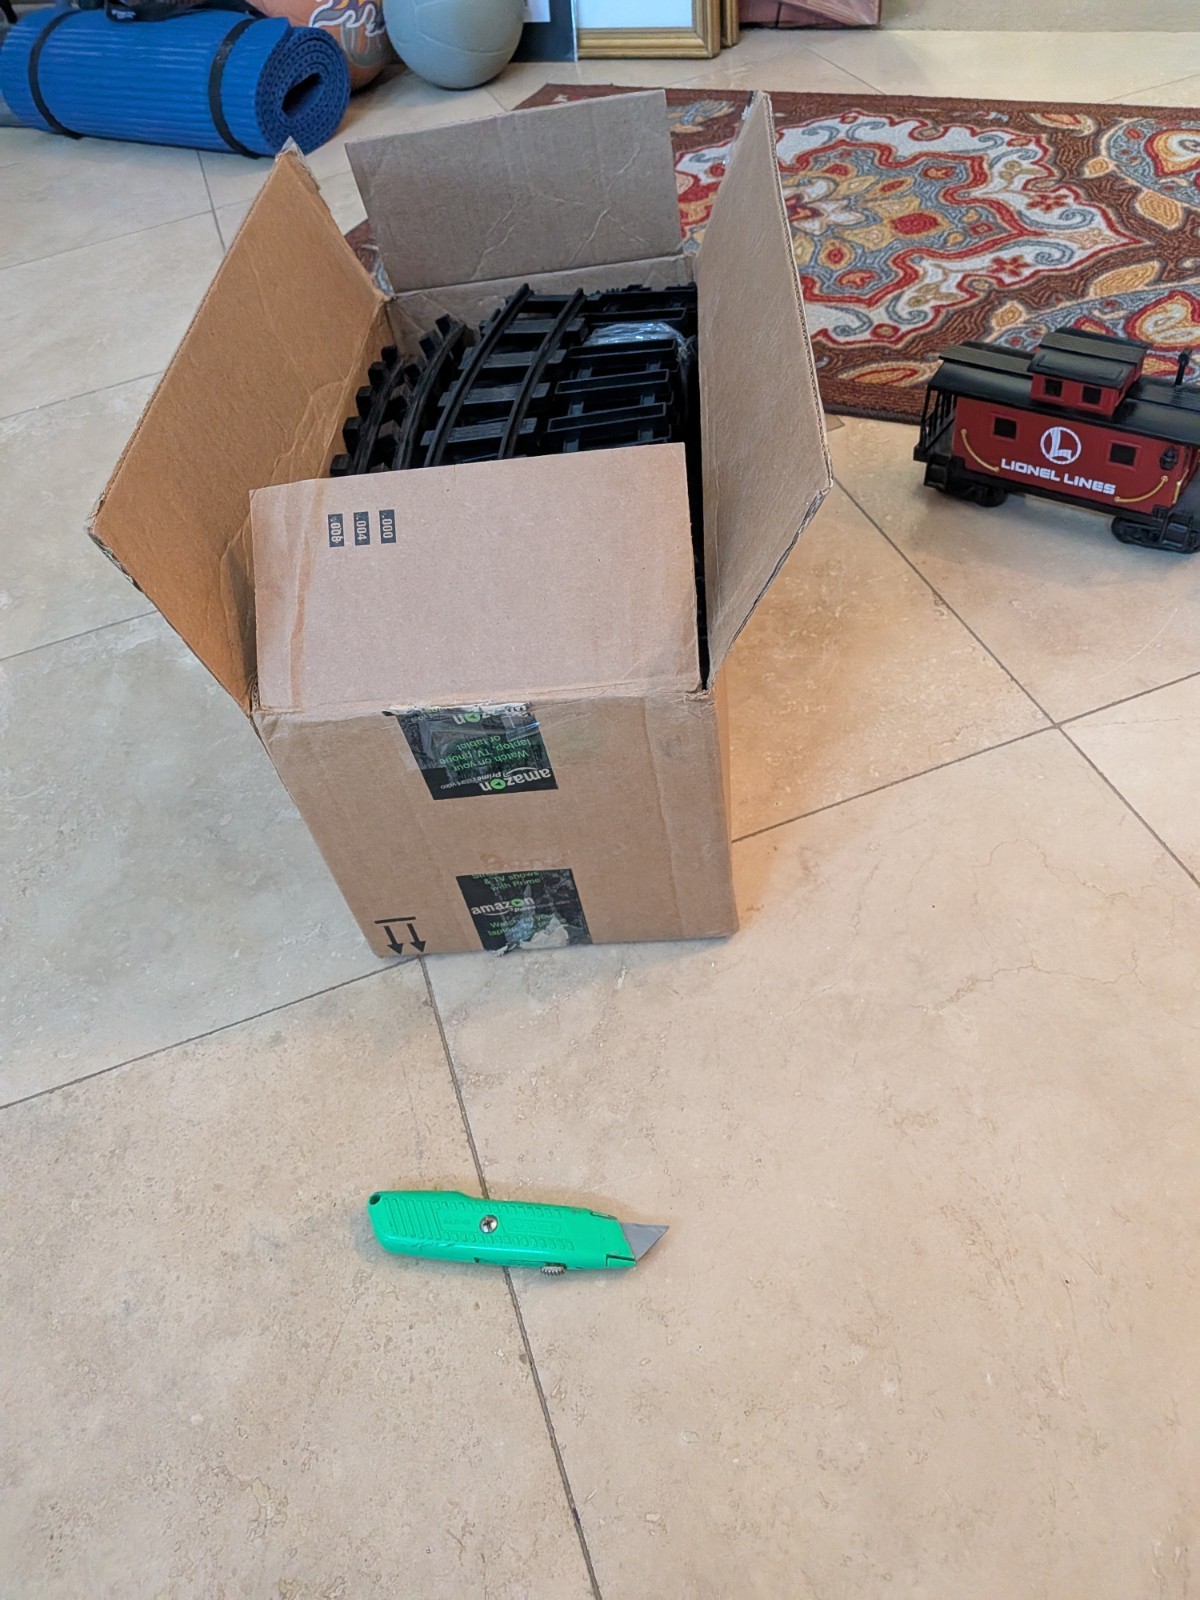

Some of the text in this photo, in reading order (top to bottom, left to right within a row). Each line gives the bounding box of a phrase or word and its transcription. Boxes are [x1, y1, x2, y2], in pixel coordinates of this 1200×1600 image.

[1000, 457, 1117, 496] LIONEL LINES
[438, 749, 473, 766] phone
[452, 749, 530, 772] Watch on your
[478, 768, 552, 792] amazon
[483, 877, 493, 885] &
[490, 878, 541, 892] with Prime
[470, 897, 535, 915] amazon
